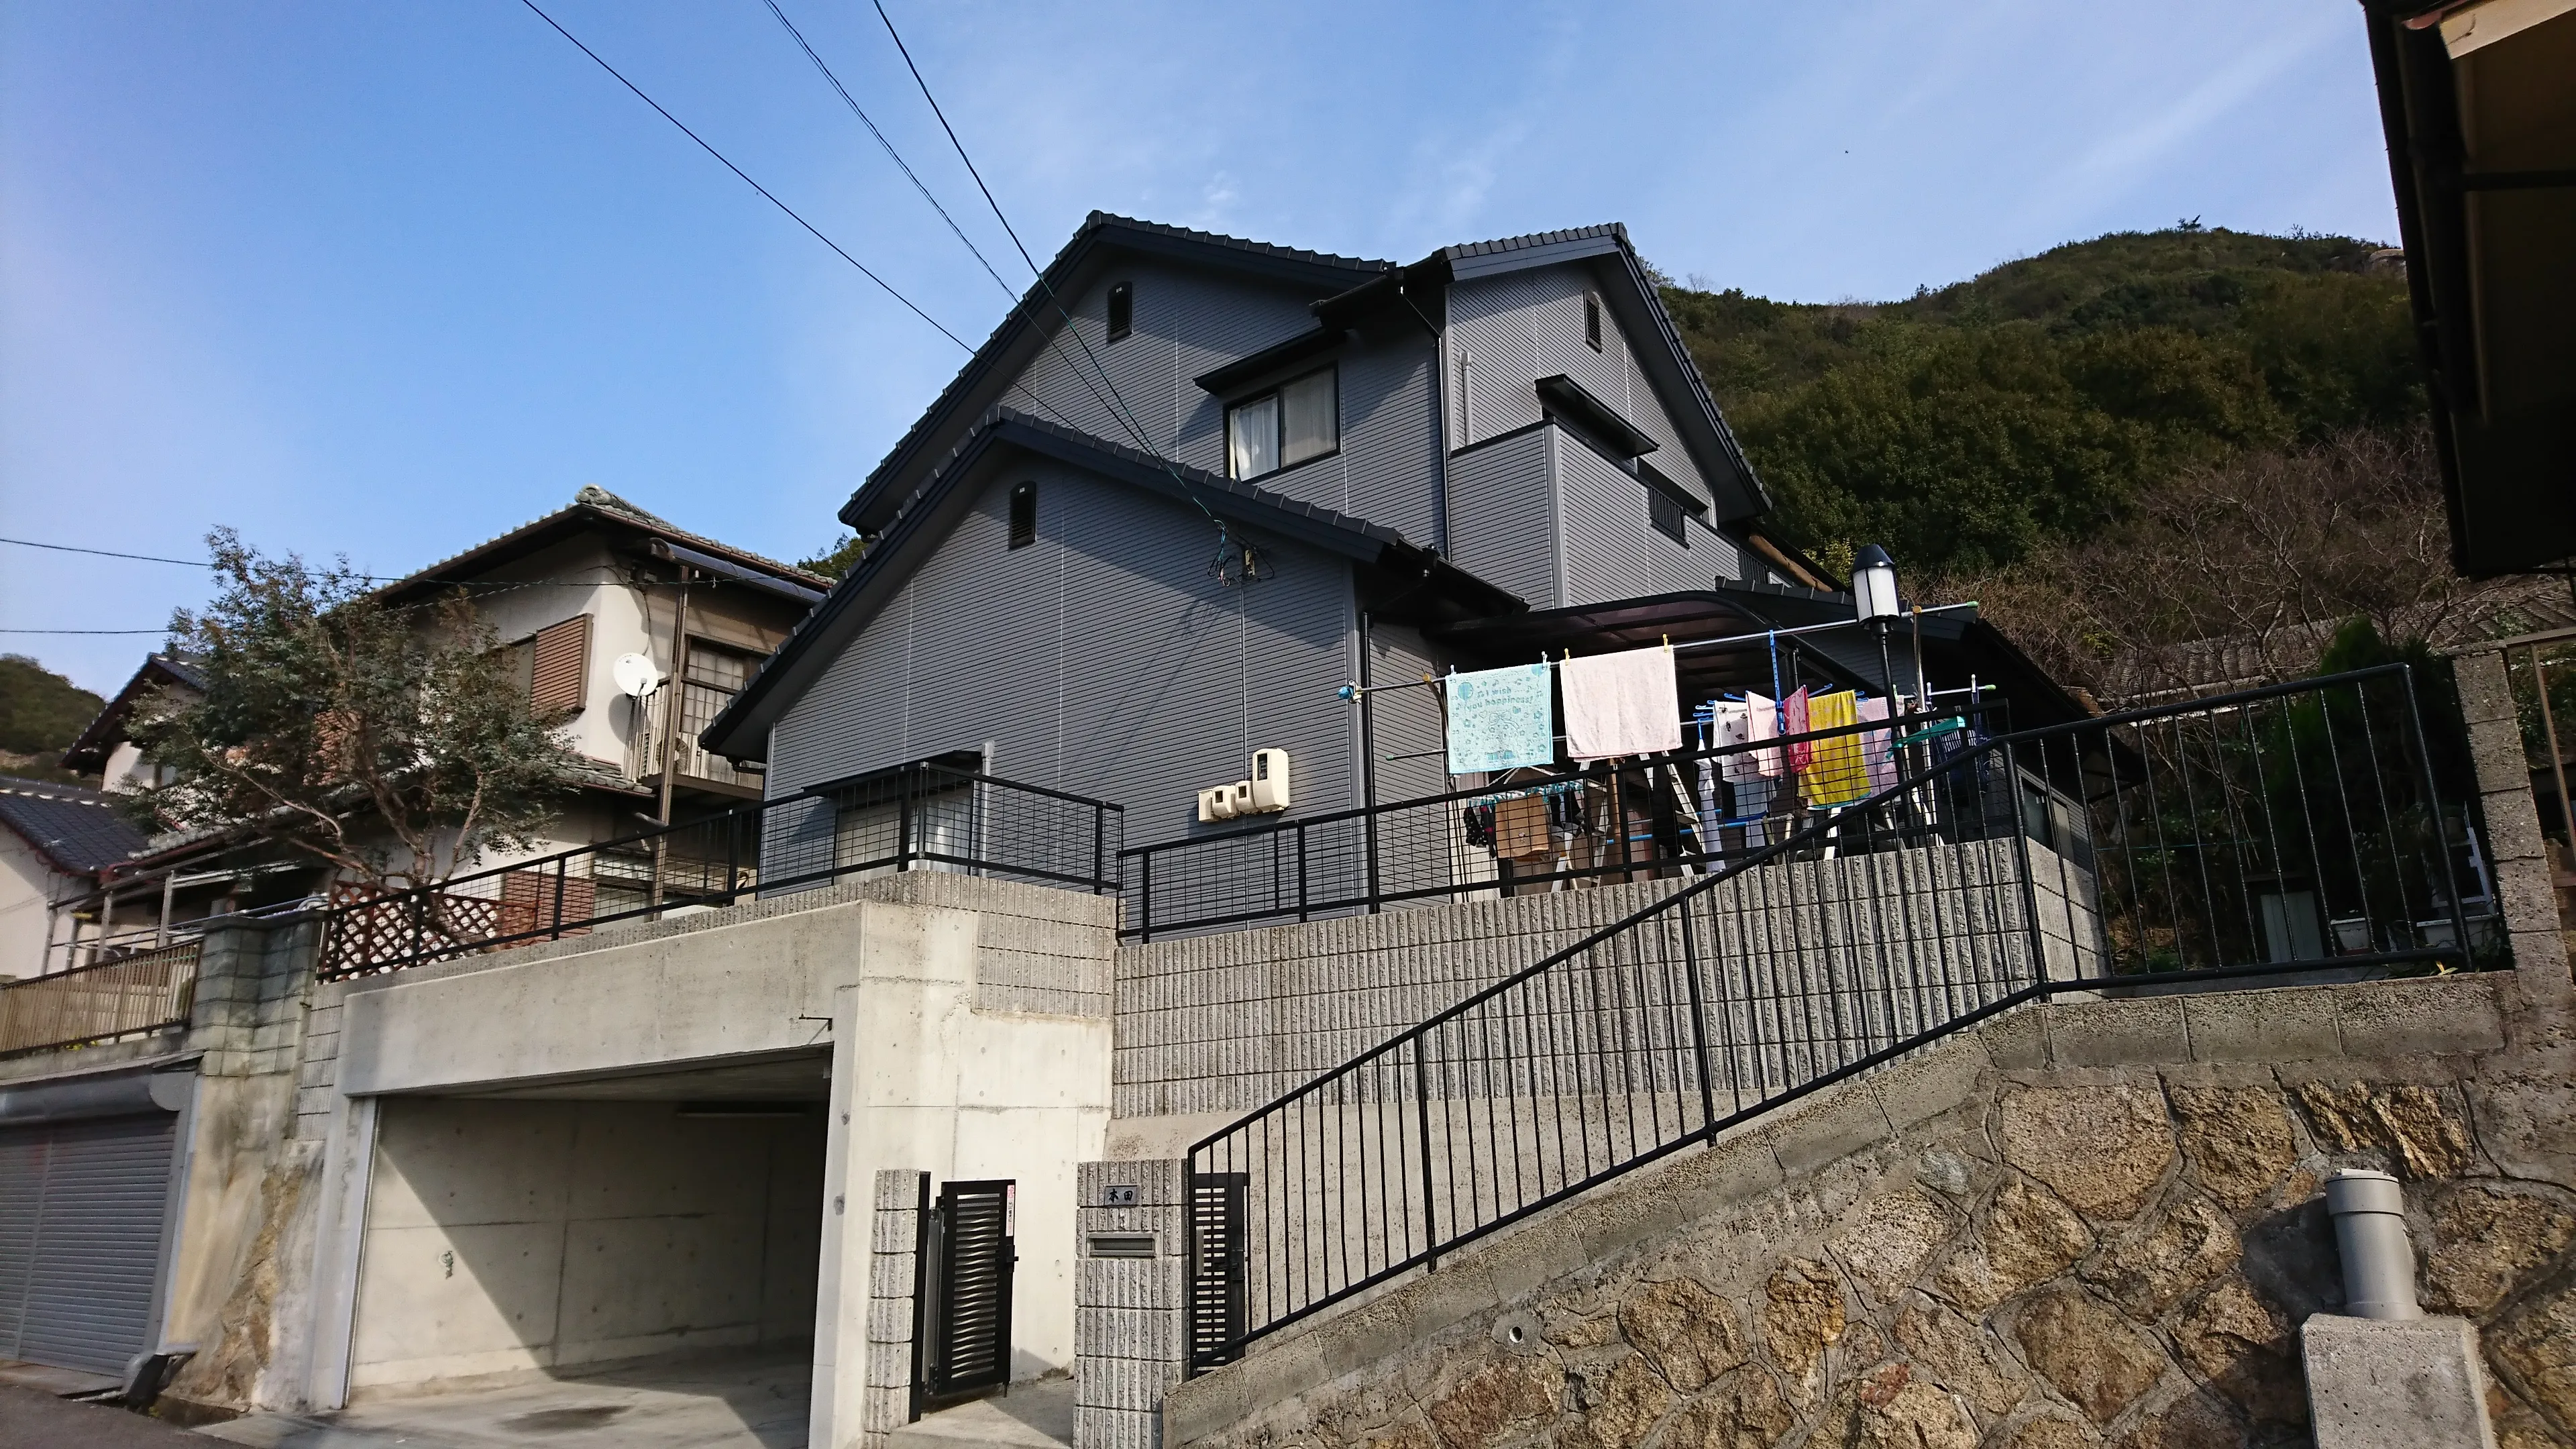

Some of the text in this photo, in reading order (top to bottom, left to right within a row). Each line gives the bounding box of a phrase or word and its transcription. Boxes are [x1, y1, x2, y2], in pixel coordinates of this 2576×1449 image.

[1492, 686, 1511, 695] wish
[1466, 702, 1482, 711] you
[1109, 1188, 1133, 1203] 本田
